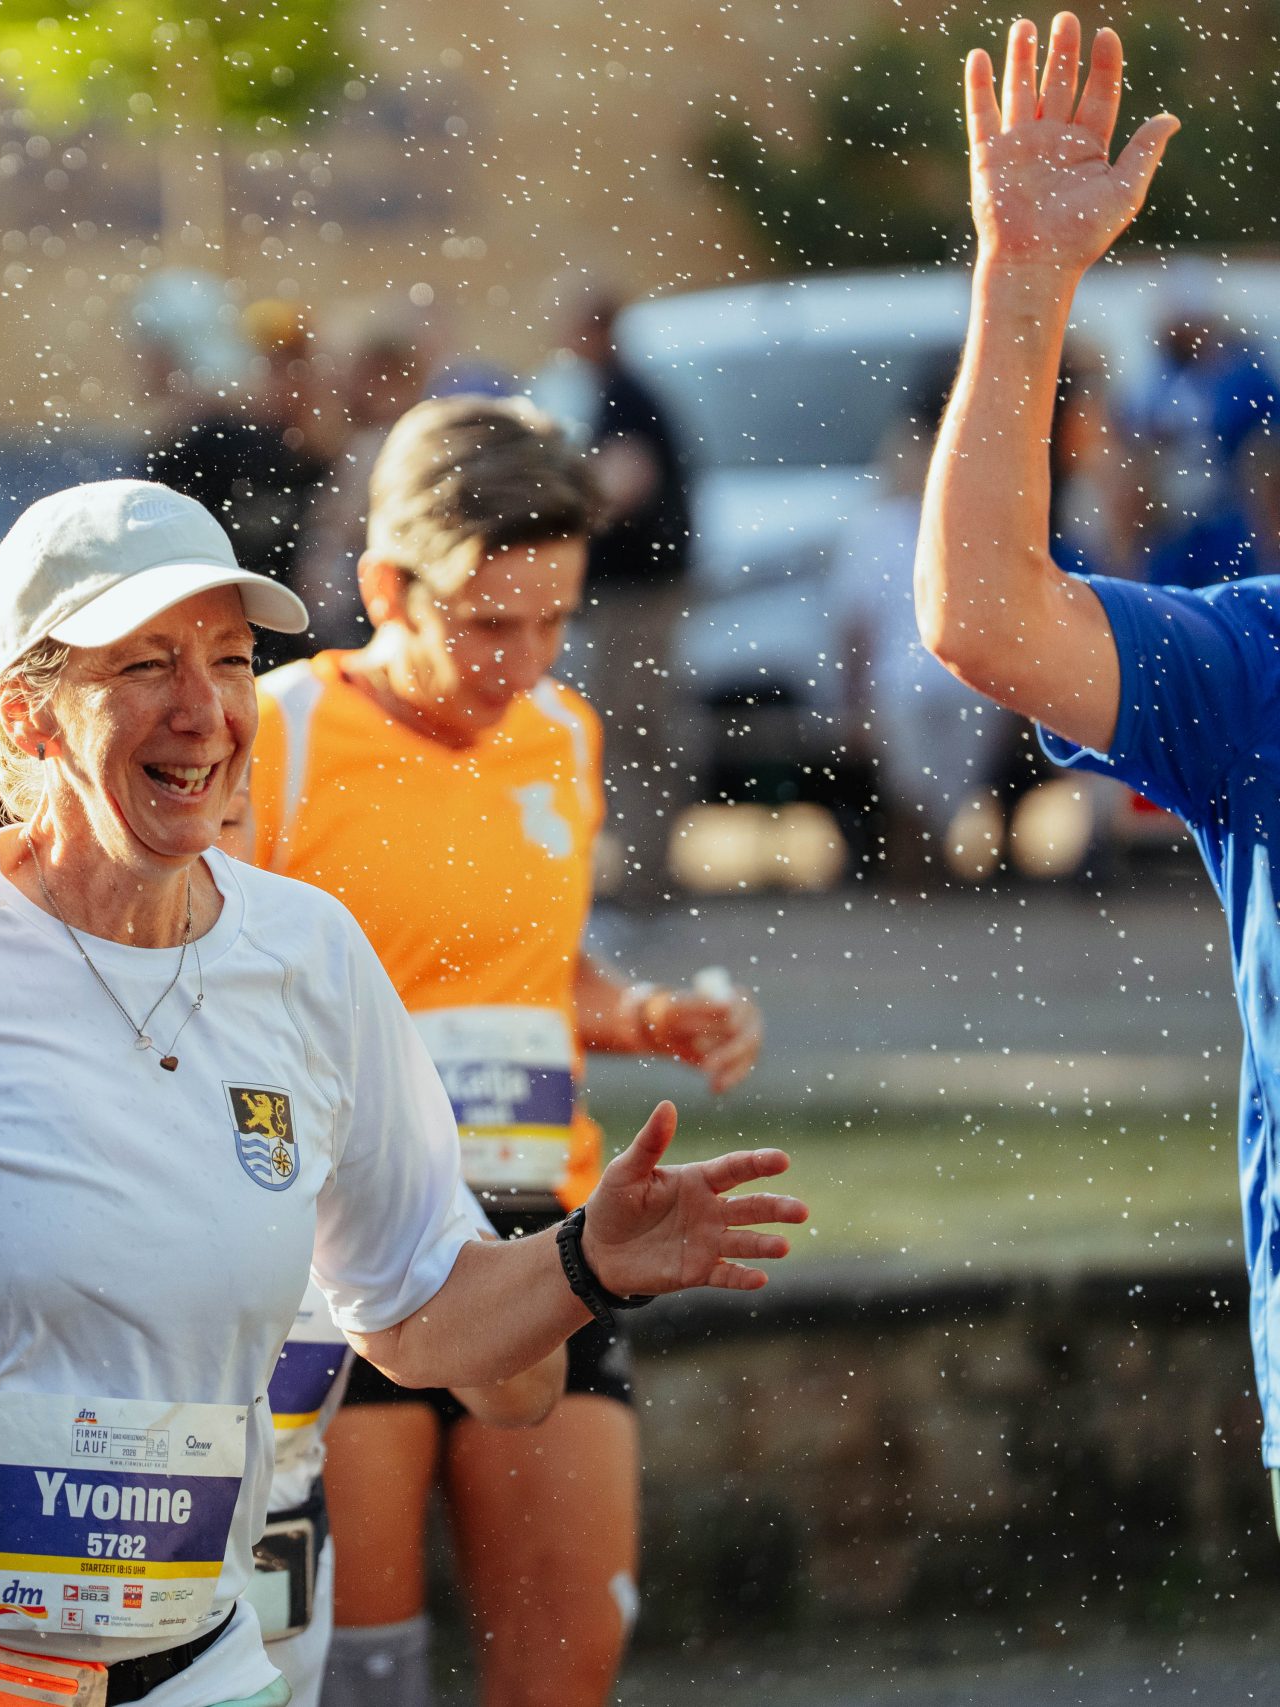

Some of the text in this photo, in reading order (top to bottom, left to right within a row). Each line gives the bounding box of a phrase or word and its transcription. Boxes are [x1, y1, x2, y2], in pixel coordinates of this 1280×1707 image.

[78, 1408, 96, 1419] dm
[76, 1428, 108, 1440] FIRMEN
[75, 1439, 108, 1454] LAUF
[33, 1470, 192, 1524] Yvonne
[87, 1532, 147, 1559] 5782
[80, 1562, 146, 1576] STARTZEIT 18:15 UHR
[1, 1579, 43, 1606] dm
[80, 1592, 110, 1602] 88.3
[123, 1586, 143, 1594] SCHUH
